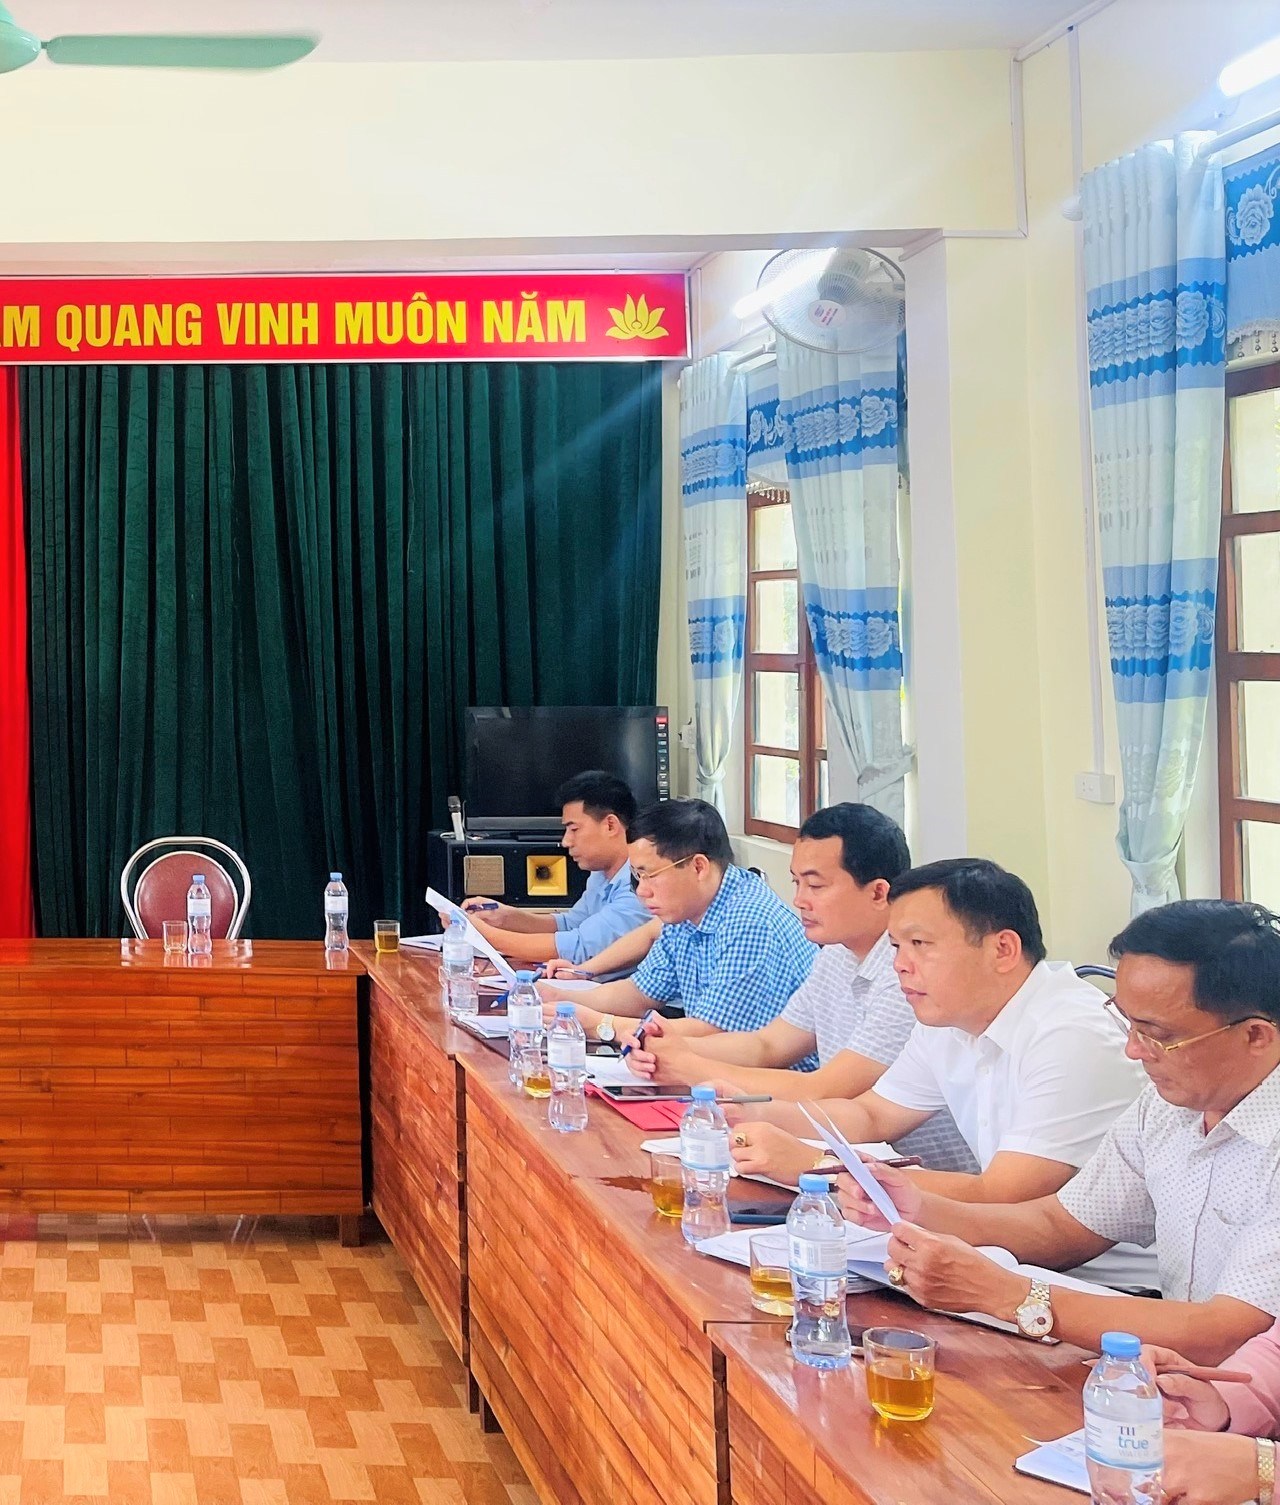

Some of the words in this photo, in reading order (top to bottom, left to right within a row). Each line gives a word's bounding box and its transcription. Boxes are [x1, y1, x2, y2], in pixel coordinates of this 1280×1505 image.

[55, 303, 202, 352] QUANG
[216, 301, 319, 345] VINH
[335, 292, 467, 344] MUÔN
[483, 290, 586, 343] NĂM
[1118, 1435, 1149, 1450] true
